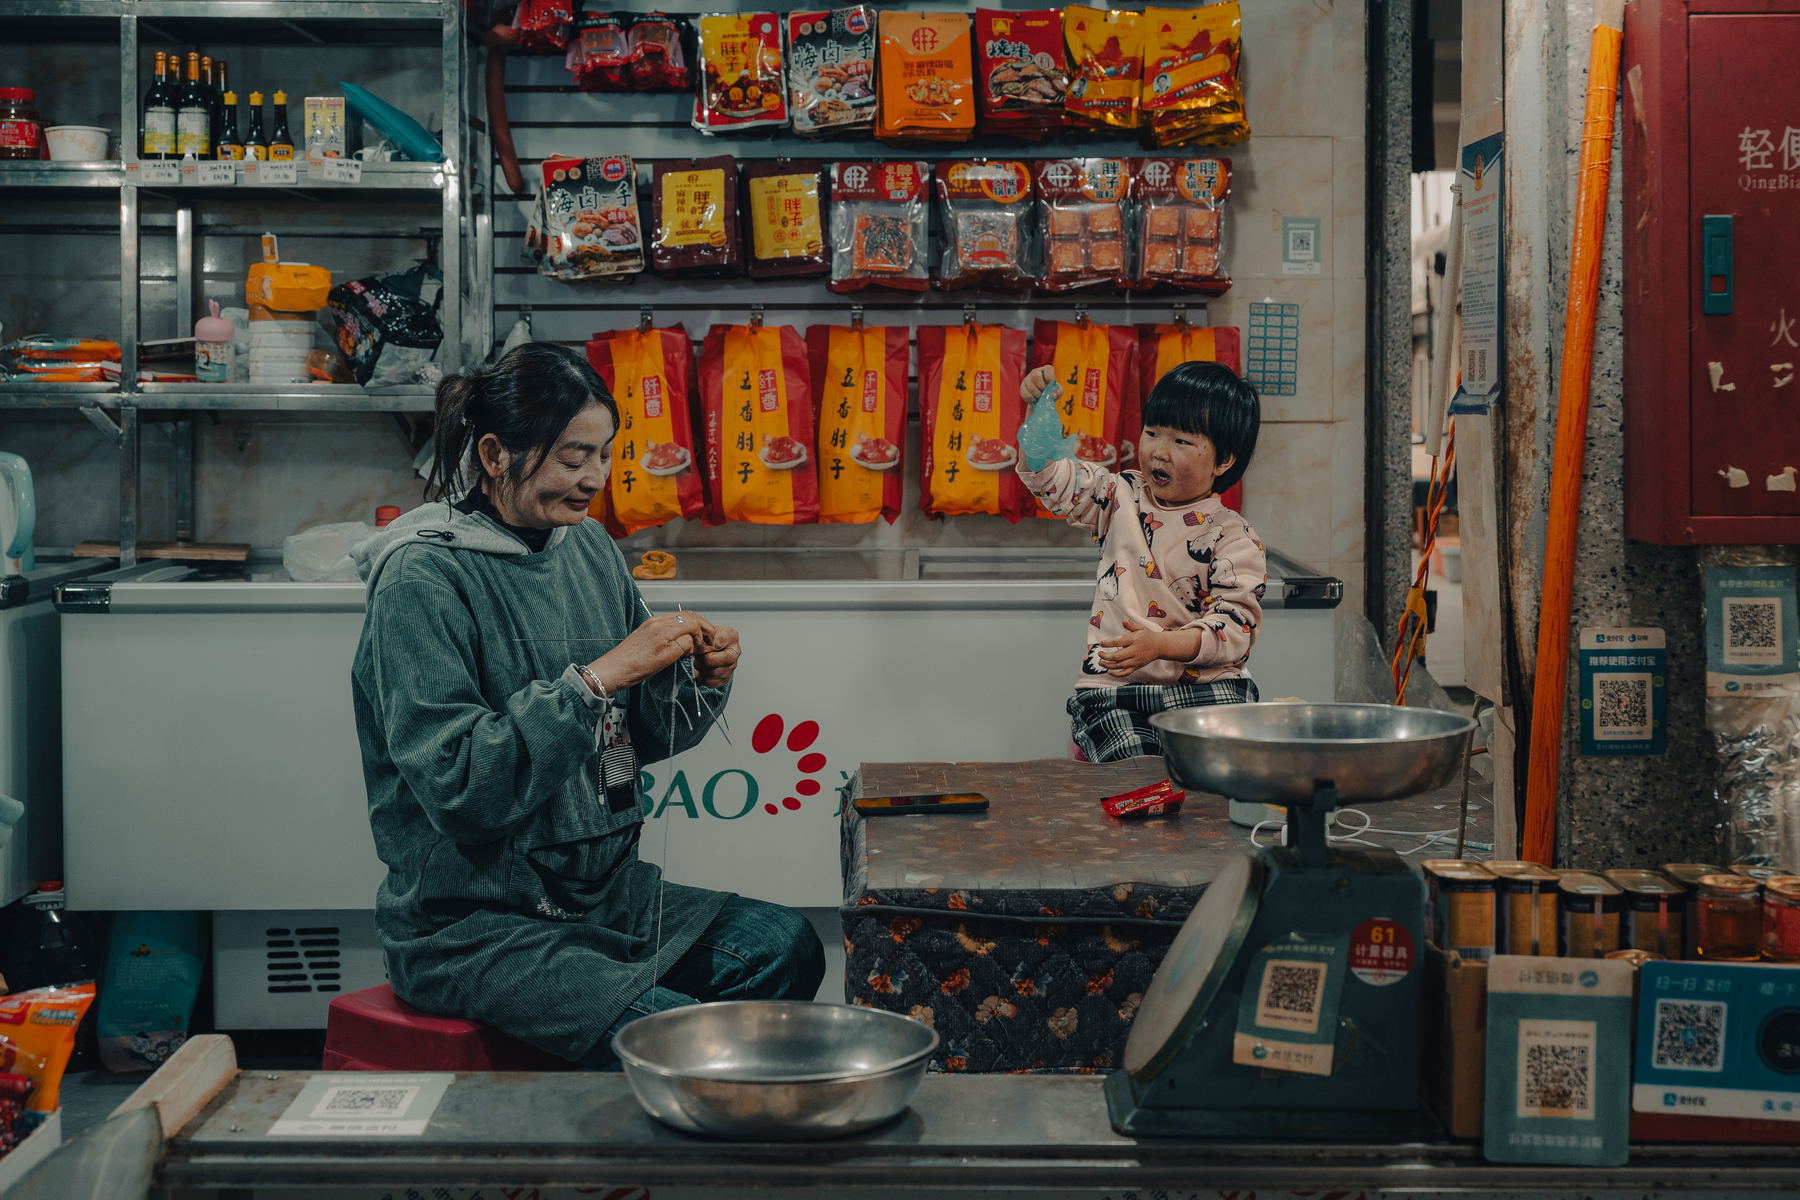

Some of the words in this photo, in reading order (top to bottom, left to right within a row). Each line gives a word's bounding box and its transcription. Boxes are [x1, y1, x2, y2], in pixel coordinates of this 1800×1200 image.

[990, 38, 1032, 66] 烧烤
[1102, 161, 1120, 189] 胖子
[1200, 161, 1219, 189] 胖子
[1769, 307, 1799, 348] 火
[830, 367, 855, 480] 五香肘子
[945, 370, 966, 483] 五香肘子
[1588, 655, 1657, 667] 推荐使用支付宝
[1370, 926, 1396, 944] 61
[1355, 944, 1408, 959] 计量器具
[1656, 975, 1697, 991] 扫一扫
